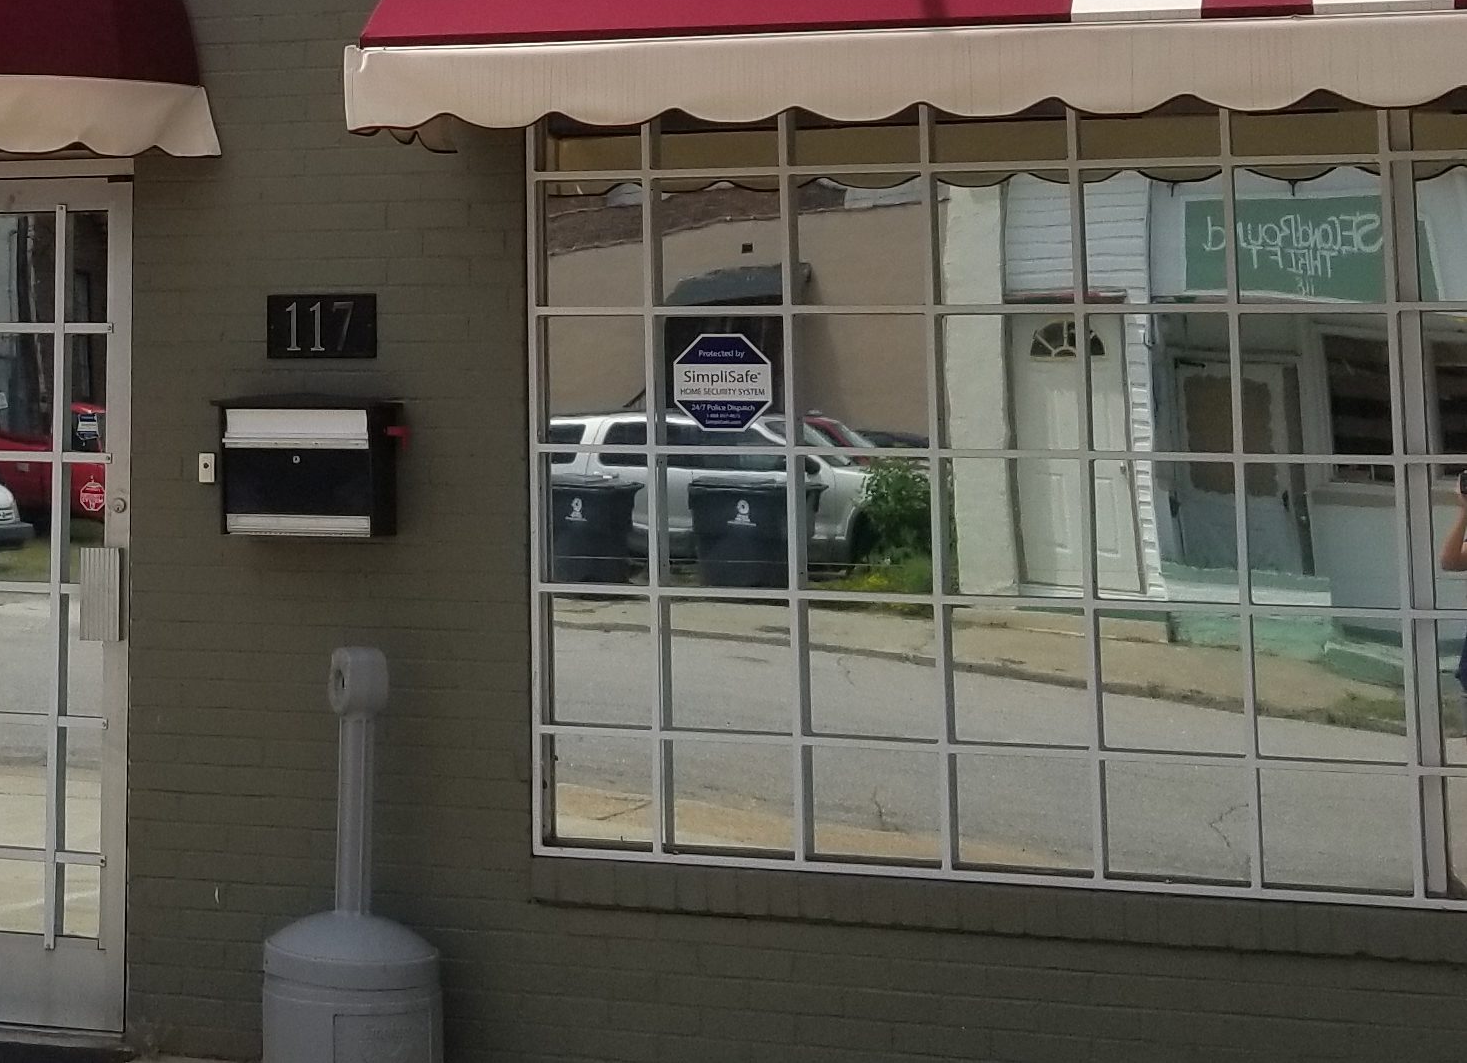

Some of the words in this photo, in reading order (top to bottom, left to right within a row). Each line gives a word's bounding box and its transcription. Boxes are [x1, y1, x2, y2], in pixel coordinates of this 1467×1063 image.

[285, 301, 355, 351] 117
[698, 349, 734, 357] Protected
[735, 349, 745, 359] by
[683, 369, 759, 386] SimpliSafe
[738, 388, 766, 396] SYSTEM
